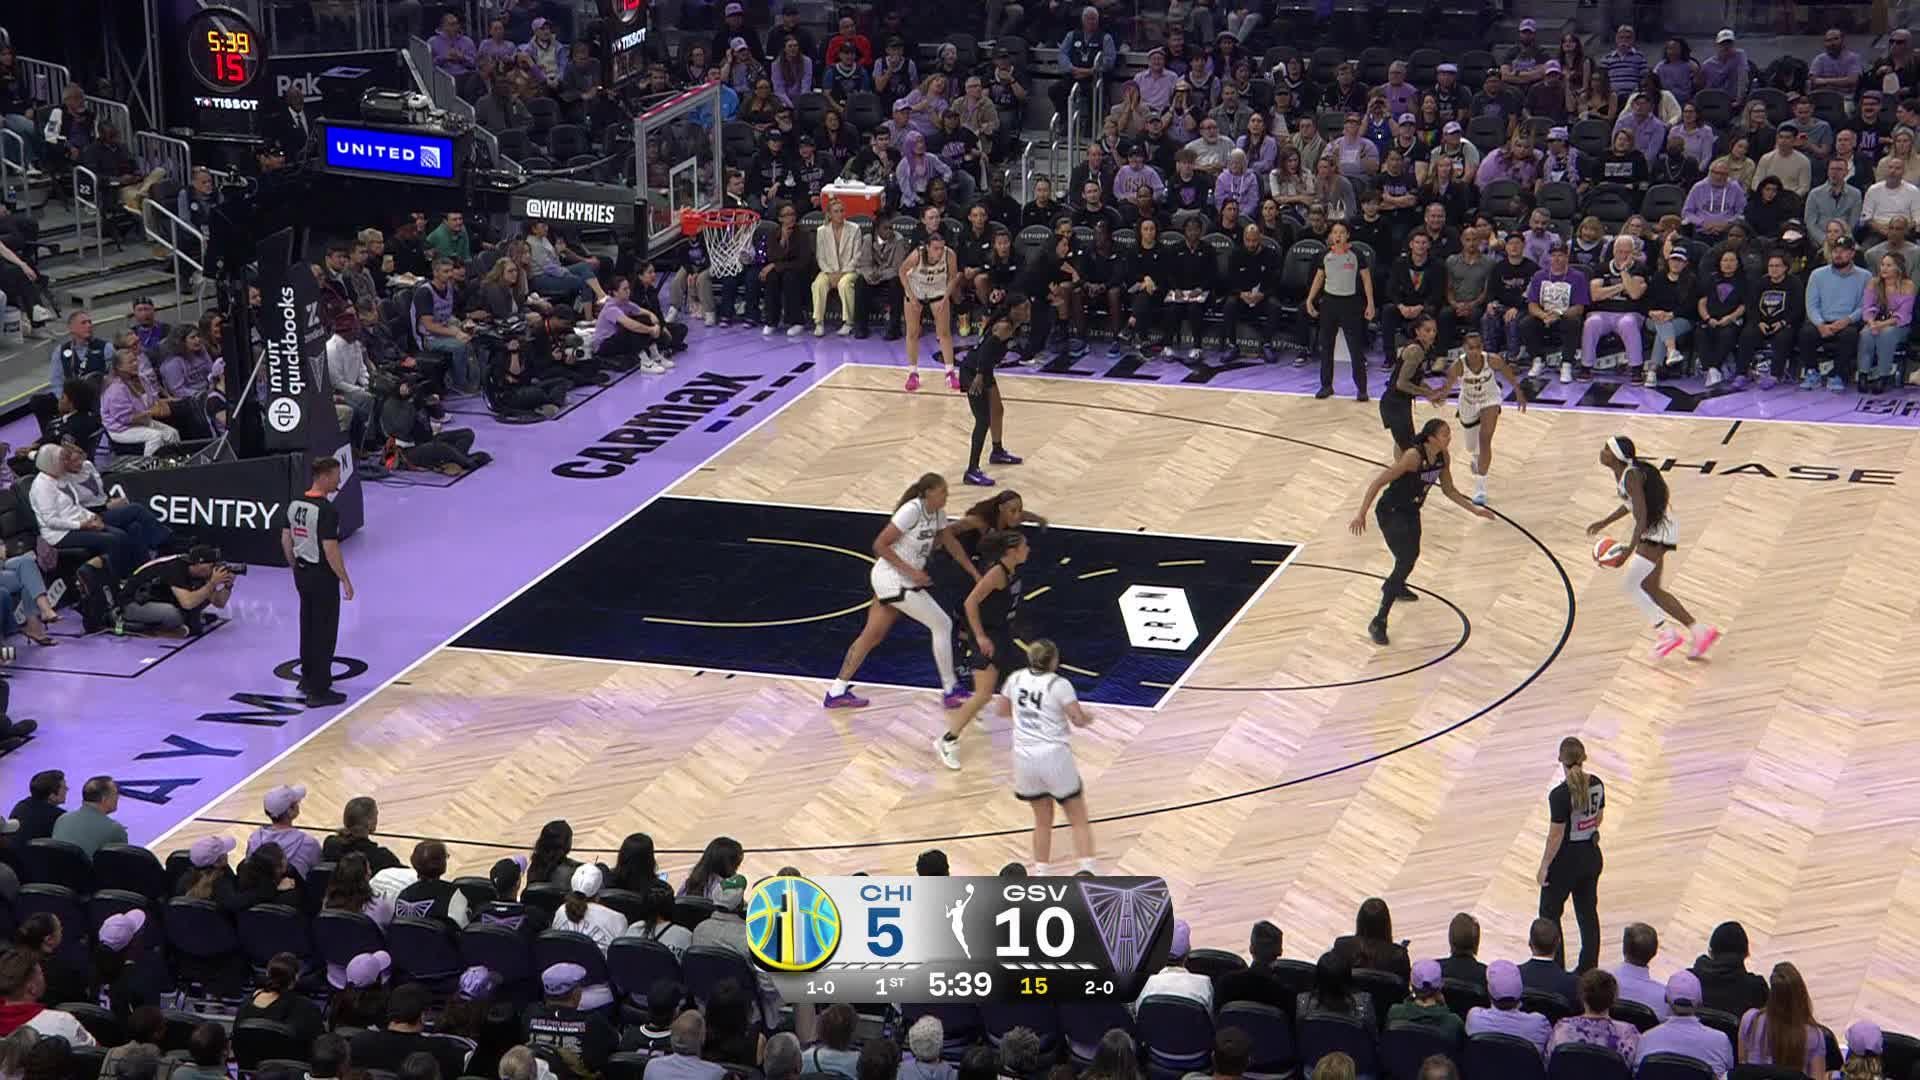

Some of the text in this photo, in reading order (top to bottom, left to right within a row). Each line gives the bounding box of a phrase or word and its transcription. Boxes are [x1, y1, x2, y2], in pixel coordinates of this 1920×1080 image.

[208, 31, 249, 53] 5:39
[216, 54, 245, 80] 15
[212, 98, 259, 110] TISSOT
[336, 141, 415, 161] UNITED
[526, 199, 615, 224] @VALKYRIES
[278, 287, 306, 395] quickbooks
[1633, 456, 1904, 486] HASE
[150, 494, 280, 530] SENTRY
[294, 506, 308, 527] 43
[1018, 688, 1043, 710] 24
